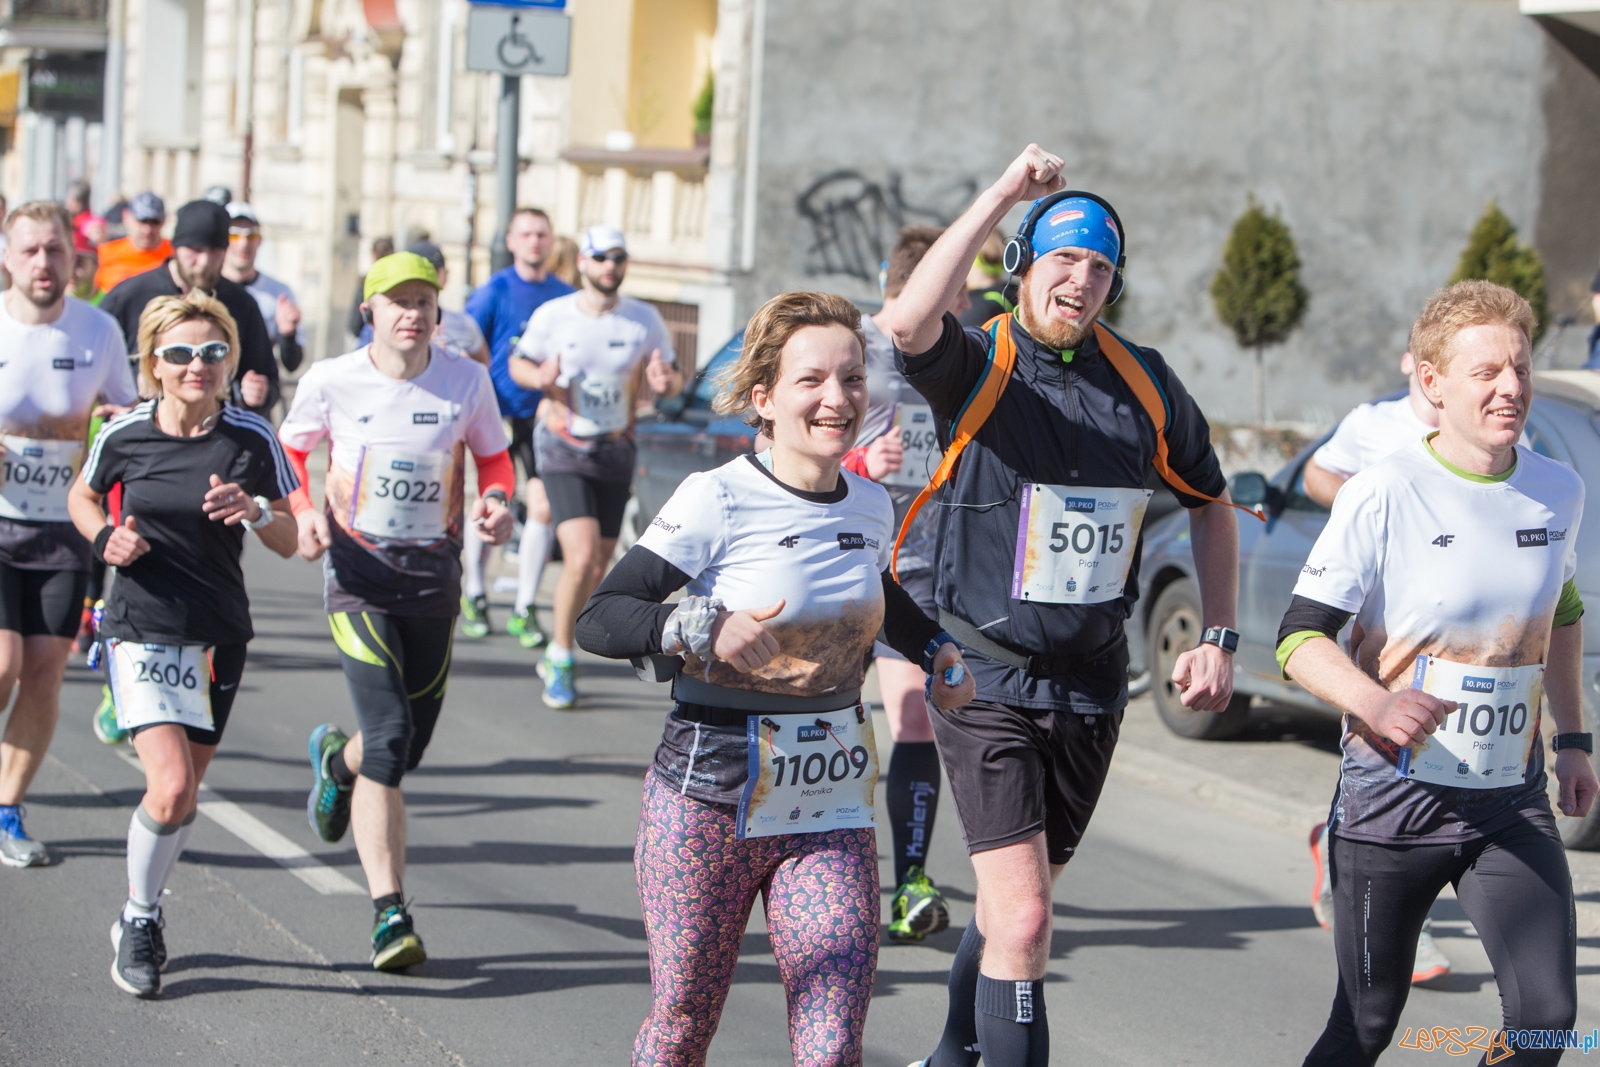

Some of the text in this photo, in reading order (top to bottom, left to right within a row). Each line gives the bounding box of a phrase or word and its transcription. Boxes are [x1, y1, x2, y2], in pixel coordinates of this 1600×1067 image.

[1051, 229, 1078, 241] LUVENA
[902, 430, 940, 452] 849
[3, 461, 73, 488] 10479
[375, 476, 441, 503] 3022
[1068, 501, 1077, 509] 10.
[778, 536, 800, 548] 4F
[851, 537, 863, 545] PKO
[1049, 522, 1125, 555] 5015
[1431, 534, 1455, 547] 4F
[1520, 534, 1530, 543] 10.
[1531, 533, 1545, 542] PKO
[1078, 559, 1099, 568] Piotr
[134, 660, 197, 690] 2606
[1465, 680, 1475, 688] 10.
[1476, 682, 1492, 690] PKO
[800, 730, 810, 738] 10.
[810, 728, 825, 737] PKO
[1472, 741, 1494, 751] Piotr
[772, 745, 869, 787] 11009
[800, 787, 833, 798] Monika
[811, 811, 825, 819] 4F
